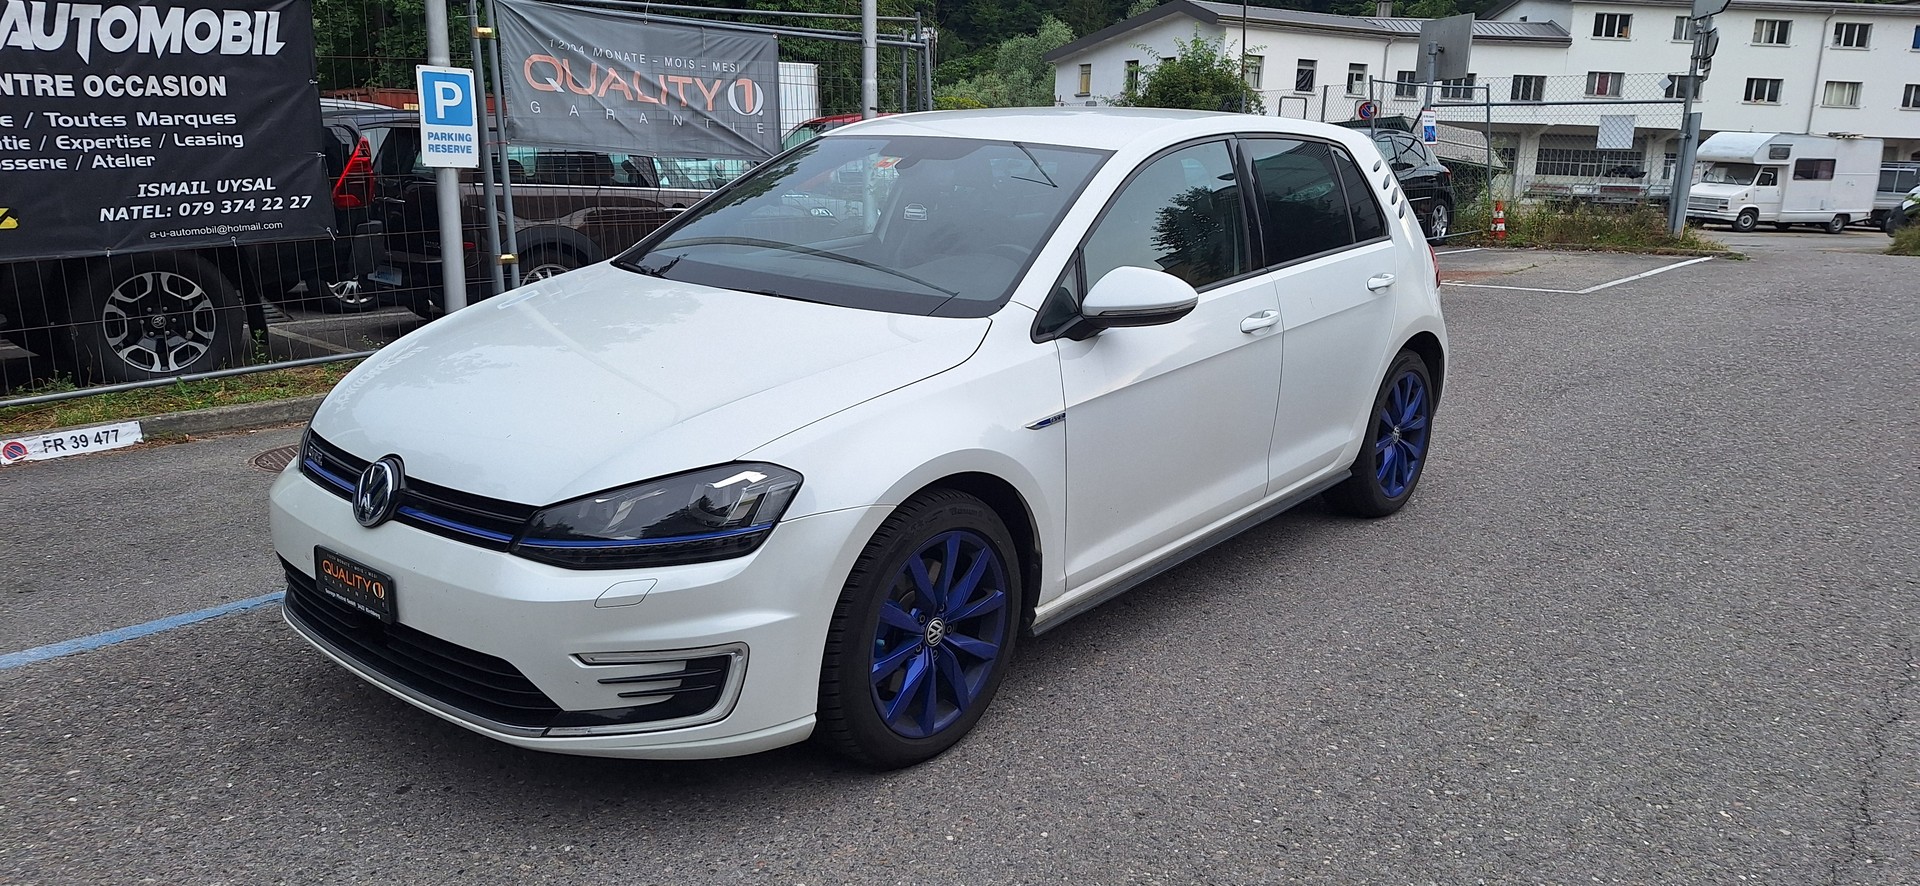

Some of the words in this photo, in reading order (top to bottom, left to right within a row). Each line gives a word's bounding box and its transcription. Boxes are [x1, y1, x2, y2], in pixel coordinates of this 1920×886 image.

[0, 0, 286, 65] AUTOMOBIL
[592, 47, 646, 64] MONATE
[664, 57, 695, 70] MOIS
[712, 62, 740, 73] MESI
[83, 75, 227, 98] OCCASION
[434, 81, 463, 119] P
[43, 112, 127, 127] Toutes
[136, 112, 237, 128] Marques
[0, 135, 31, 150] tie
[55, 133, 152, 153] Expertise
[173, 132, 244, 148] Leasing
[427, 131, 472, 142] PARKING
[428, 143, 472, 154] RESERVE
[91, 154, 156, 169] Atelier
[137, 181, 210, 198] ISMAIL
[216, 177, 276, 194] UYSAL
[99, 205, 172, 222] NATEL:
[178, 201, 215, 217] 079
[220, 199, 256, 214] 374
[261, 197, 283, 211] 22
[289, 195, 312, 209] 27
[150, 221, 283, 239] a-u-automobil@hotmail.com
[43, 438, 67, 453] FR
[70, 434, 89, 449] 39
[94, 429, 119, 445] 477
[322, 559, 371, 593] QUALITY
